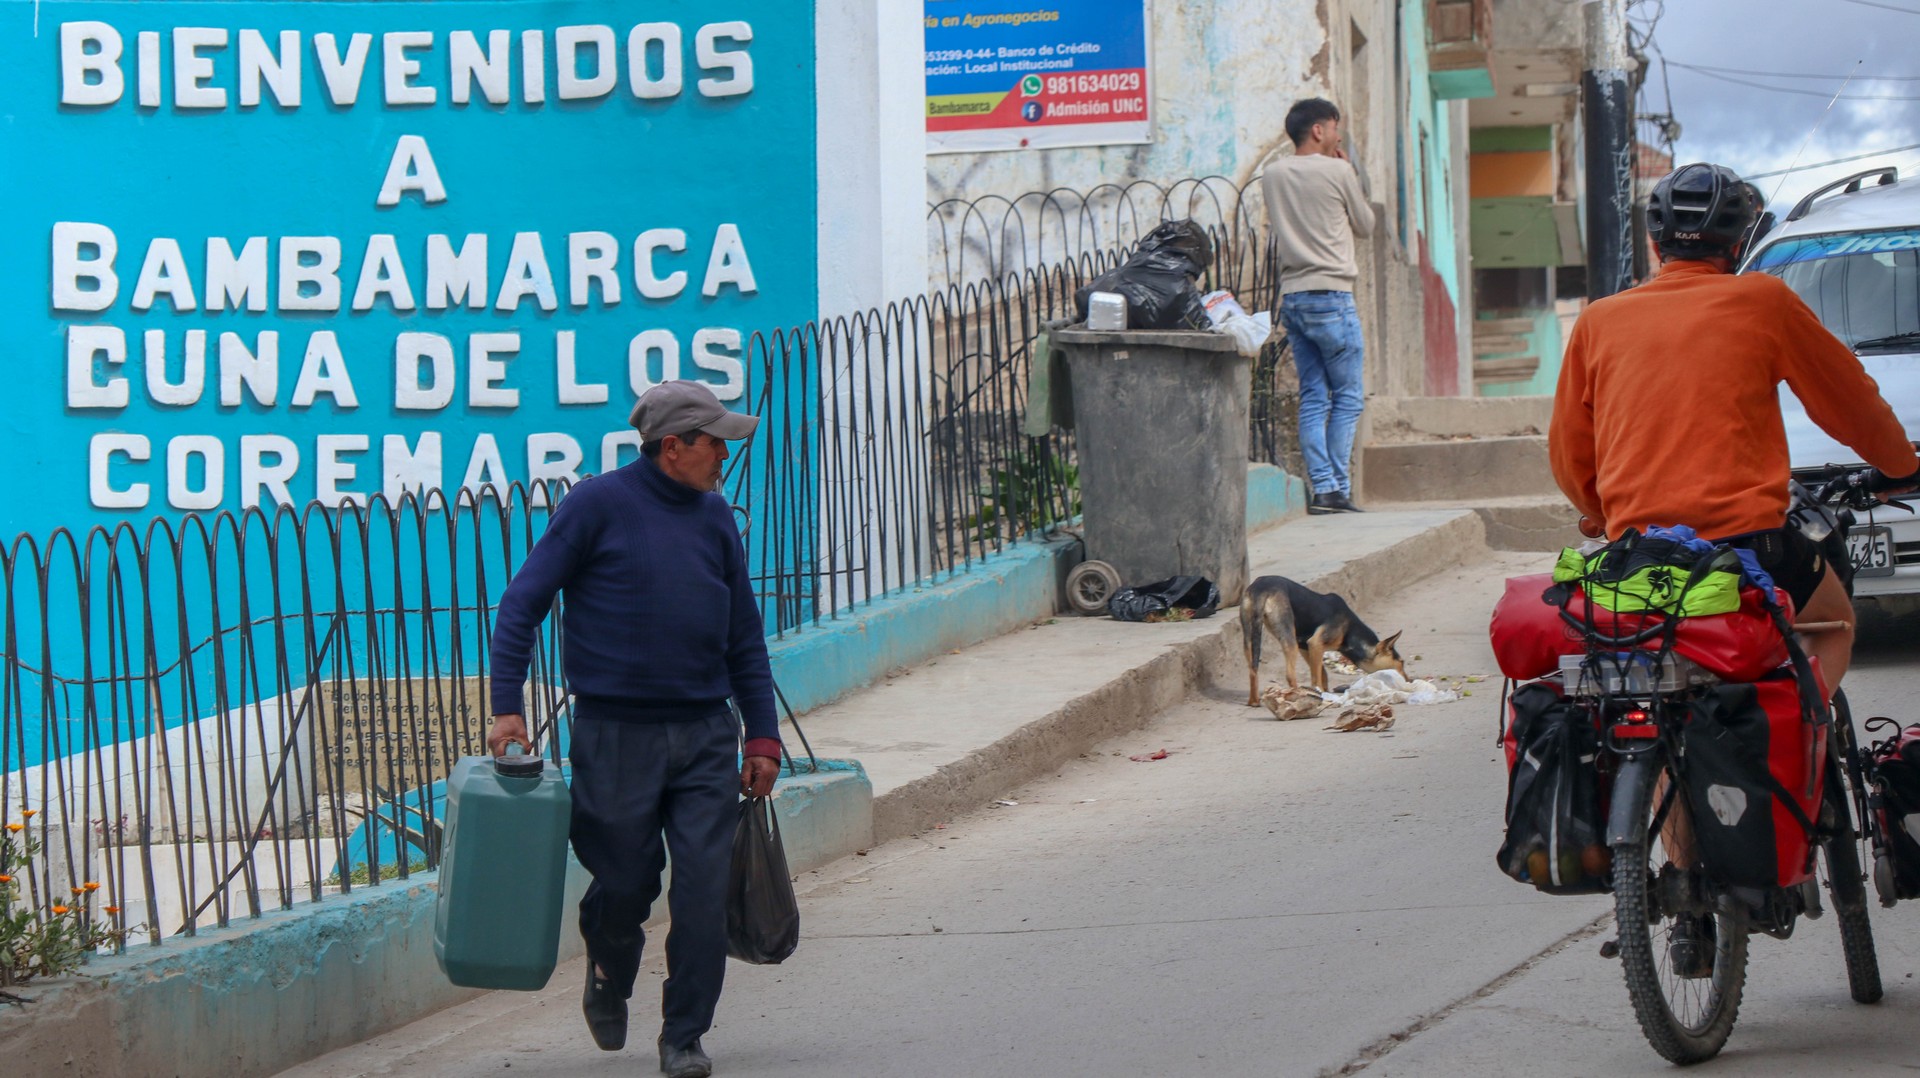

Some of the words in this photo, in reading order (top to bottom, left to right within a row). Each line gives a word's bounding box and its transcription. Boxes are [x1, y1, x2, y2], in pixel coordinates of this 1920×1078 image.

[941, 15, 960, 28] en
[962, 9, 1059, 28] Agronegocios
[997, 46, 1035, 59] Banco
[1038, 43, 1054, 56] de
[1056, 41, 1101, 55] Crédito
[60, 20, 755, 108] BIENVENIDOS
[965, 60, 998, 75] Local
[1000, 56, 1074, 72] Institucional
[1047, 72, 1140, 95] 981634029
[929, 102, 991, 115] Bambamarca
[1046, 100, 1110, 118] Admisión
[1112, 96, 1144, 114] UNC
[376, 135, 448, 205] A
[52, 221, 758, 311] BAMBAMARCA
[67, 325, 359, 408] CUNA
[395, 332, 520, 411] DE
[556, 328, 745, 404] LOS
